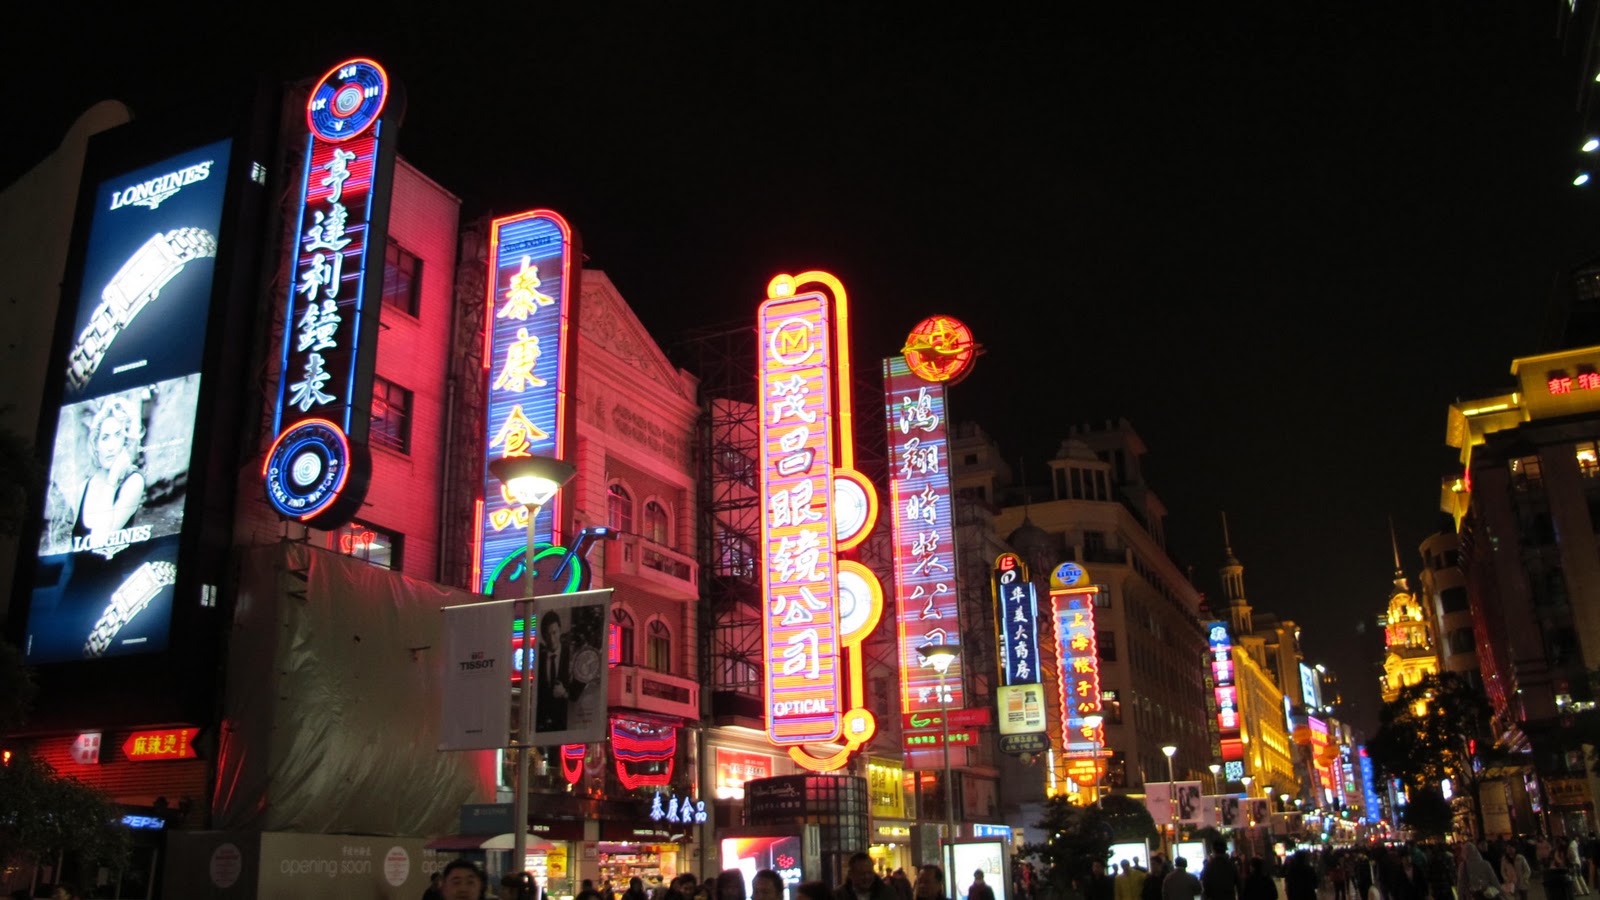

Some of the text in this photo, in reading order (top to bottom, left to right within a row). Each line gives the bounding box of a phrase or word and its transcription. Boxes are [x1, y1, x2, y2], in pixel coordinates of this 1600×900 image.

[110, 162, 210, 210] LONGINES
[1548, 372, 1600, 394] 新雅
[287, 498, 306, 507] AND
[74, 525, 151, 552] LOGINES
[459, 659, 495, 671] TISSOT
[774, 698, 829, 717] OPTICAL
[650, 790, 708, 823] 泰康食品
[280, 857, 338, 877] opening
[341, 859, 371, 874] soon
